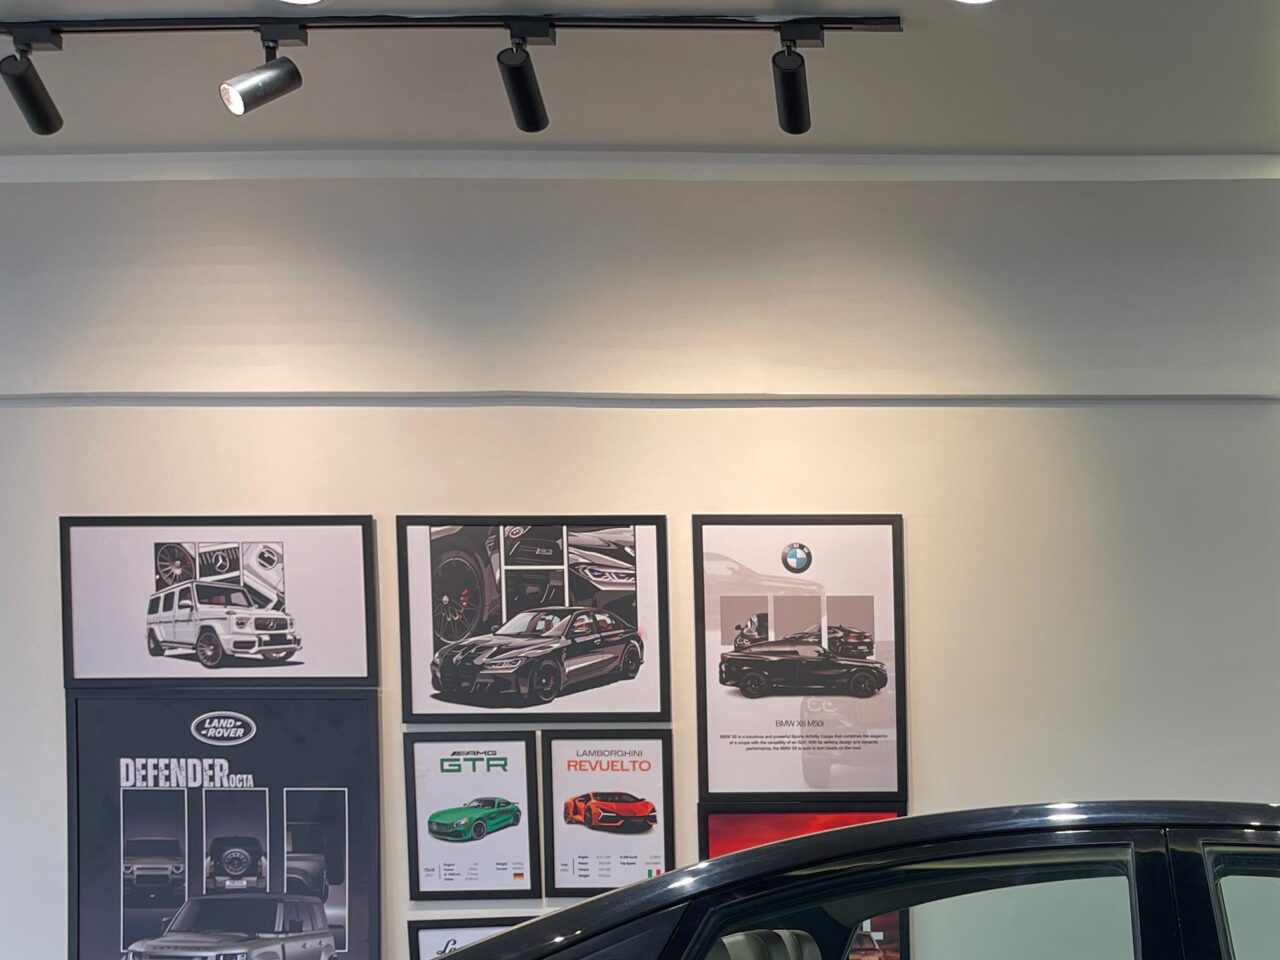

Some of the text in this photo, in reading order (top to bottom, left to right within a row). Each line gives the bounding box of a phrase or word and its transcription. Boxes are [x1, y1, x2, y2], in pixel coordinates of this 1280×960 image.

[204, 719, 235, 728] LAND
[775, 720, 795, 728] BMW
[207, 728, 245, 737] ROVER
[440, 757, 508, 773] GTR
[567, 760, 651, 772] REVUELTO
[120, 758, 254, 788] DEFENDER OCTA
